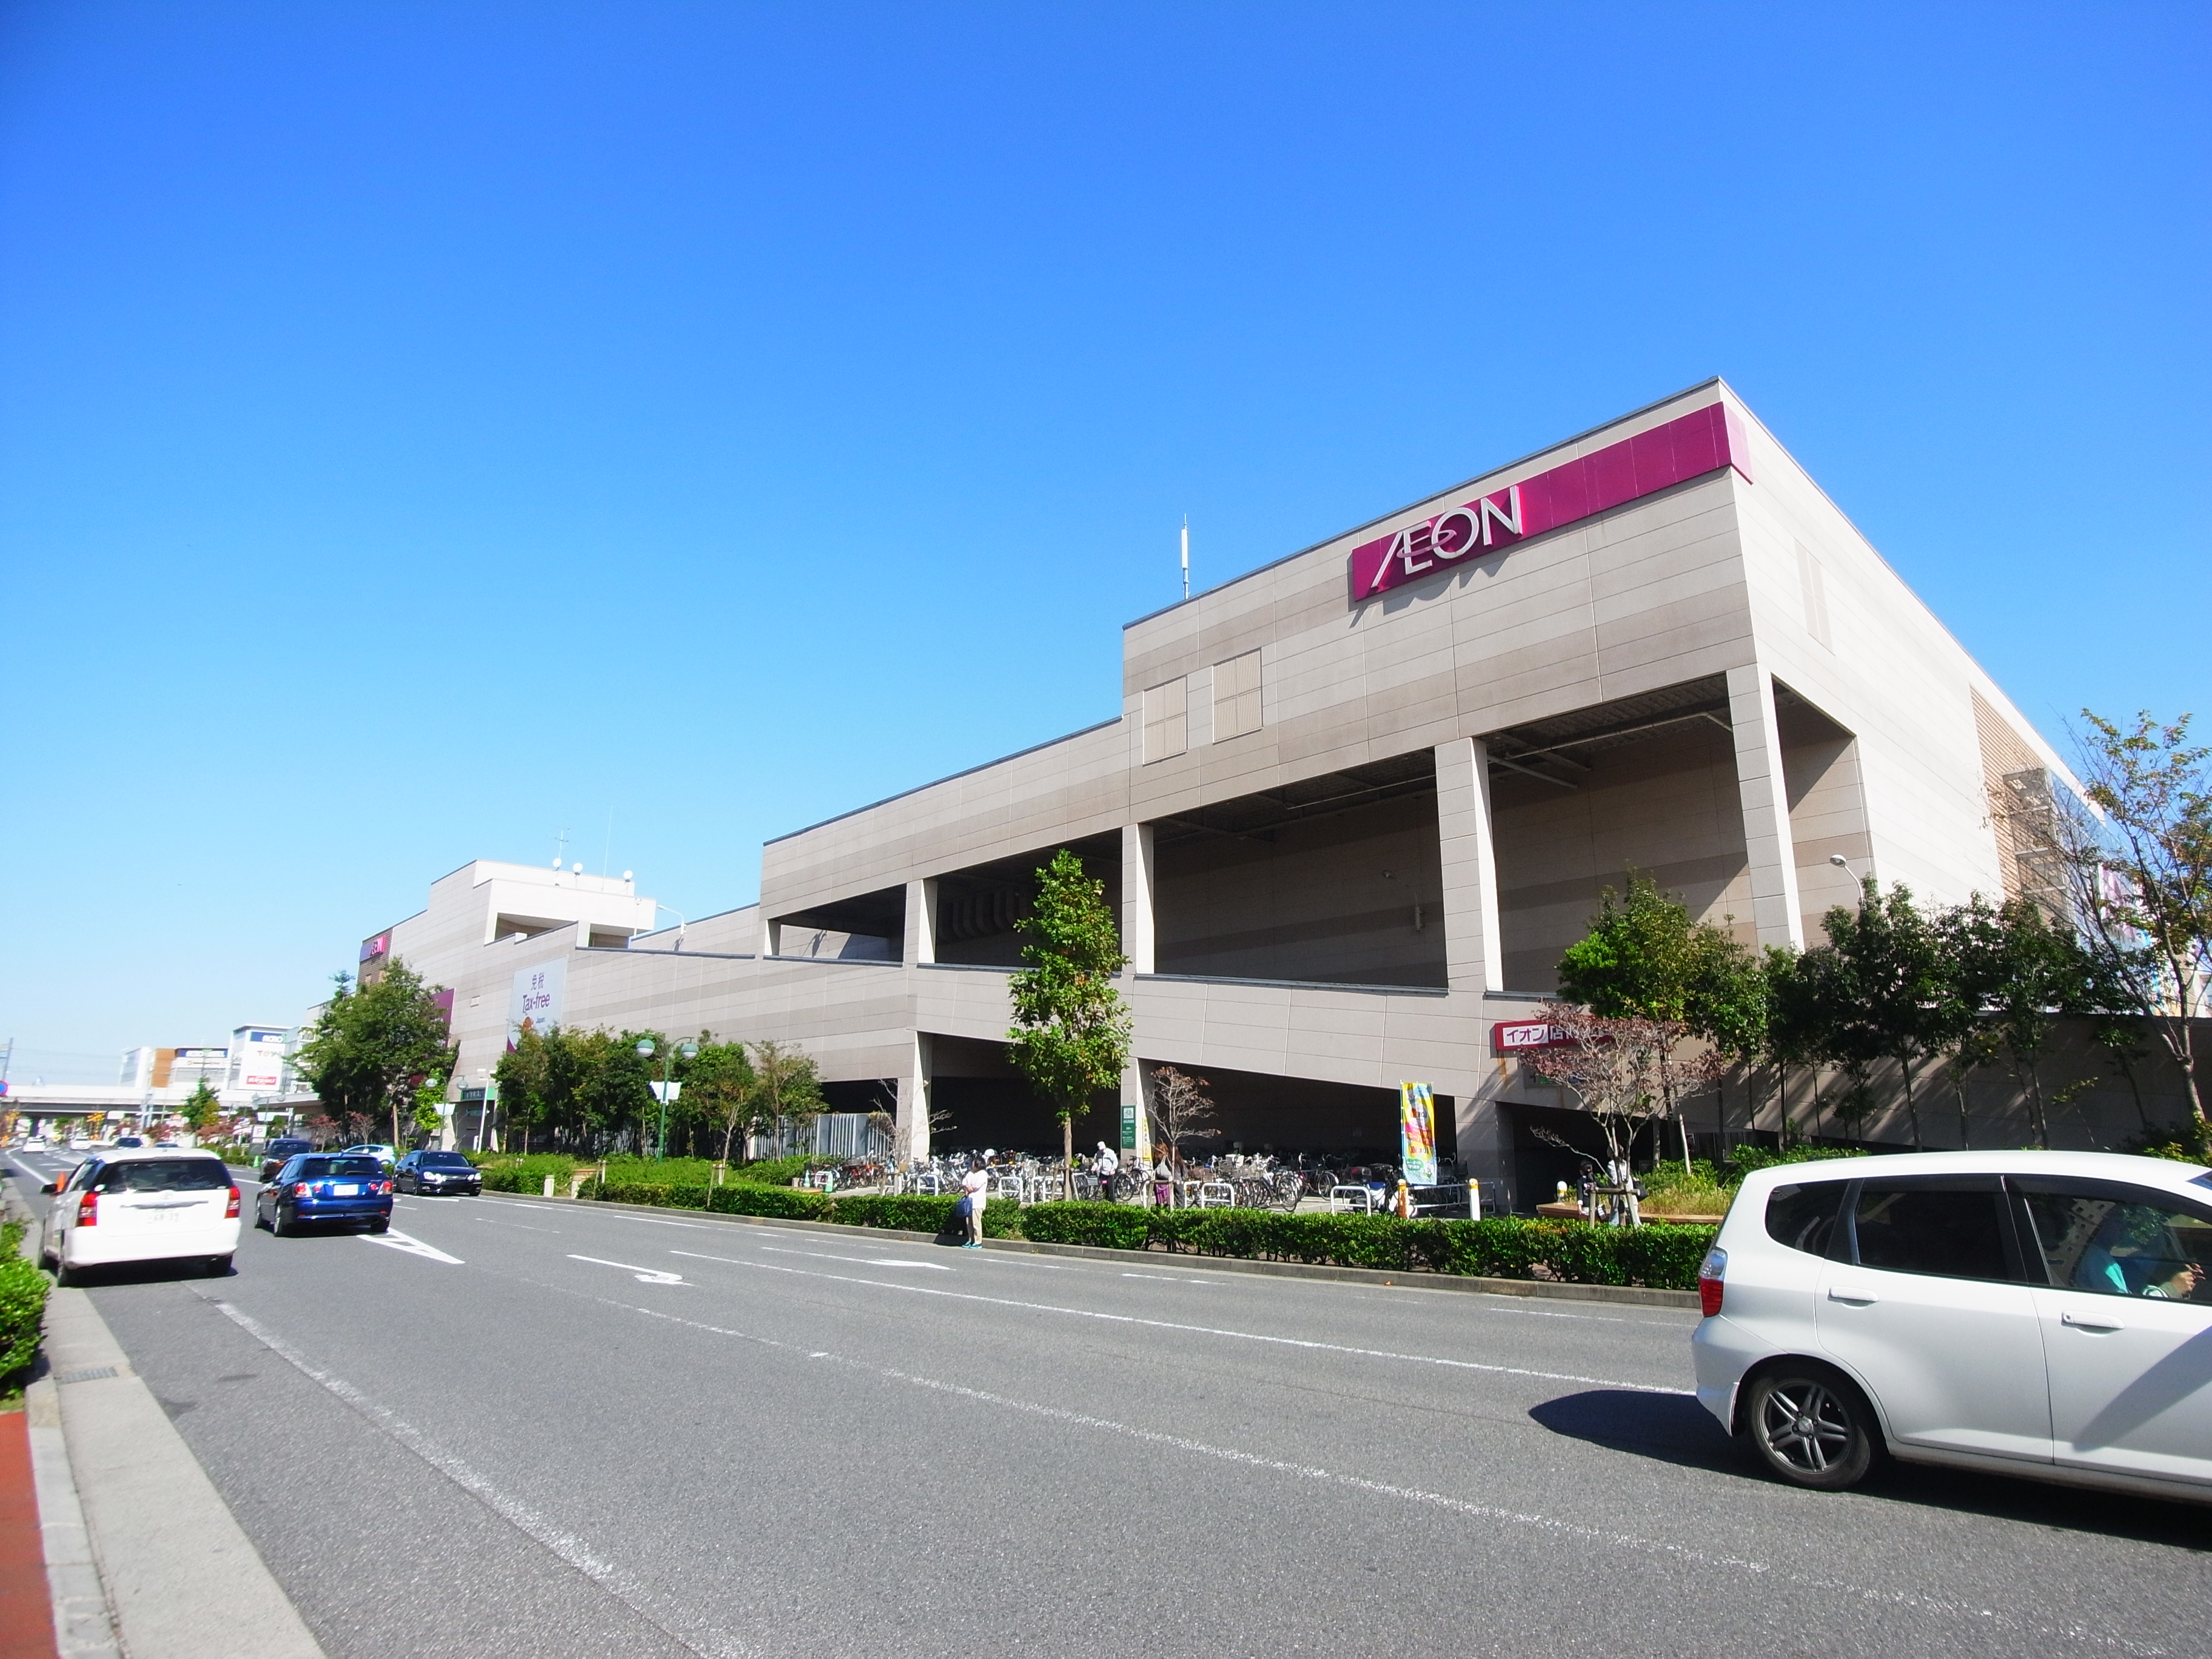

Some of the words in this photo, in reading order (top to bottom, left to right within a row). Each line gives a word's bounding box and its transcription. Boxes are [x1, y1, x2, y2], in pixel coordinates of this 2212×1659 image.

[531, 971, 545, 991] 免税
[523, 991, 551, 1013] Tax-free
[1507, 1027, 1545, 1043] イオン
